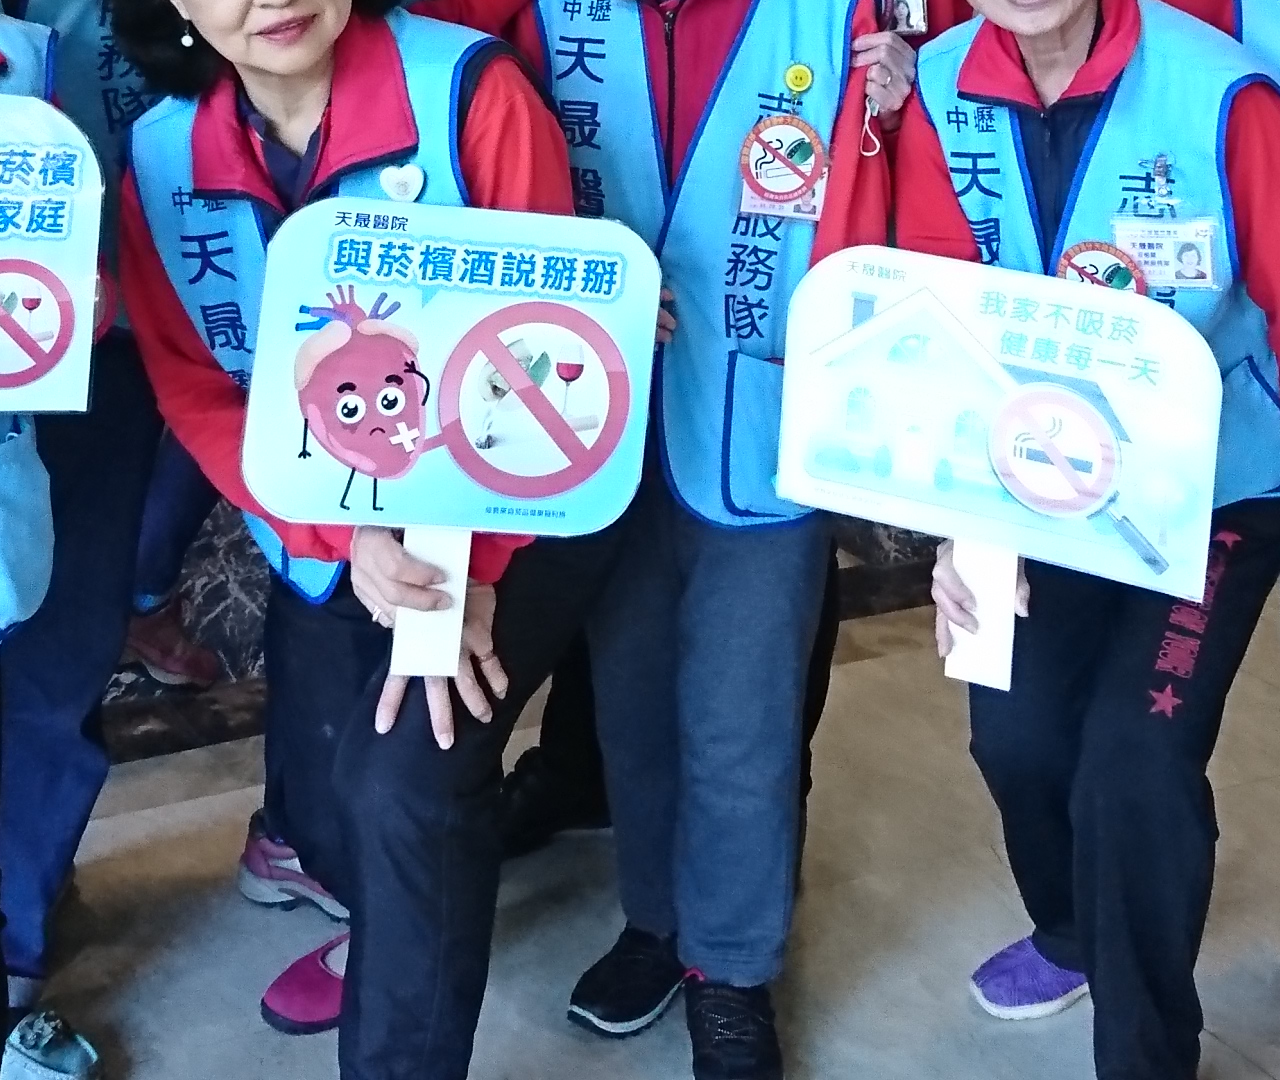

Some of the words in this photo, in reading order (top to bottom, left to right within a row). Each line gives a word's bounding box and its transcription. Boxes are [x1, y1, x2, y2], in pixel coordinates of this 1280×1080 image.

[947, 106, 996, 133] 中壢
[334, 210, 409, 232] 天晟醫院
[846, 260, 908, 283] 天晟醫院
[979, 290, 1140, 345] 我家不吸菸
[1000, 330, 1161, 387] 健康每一天
